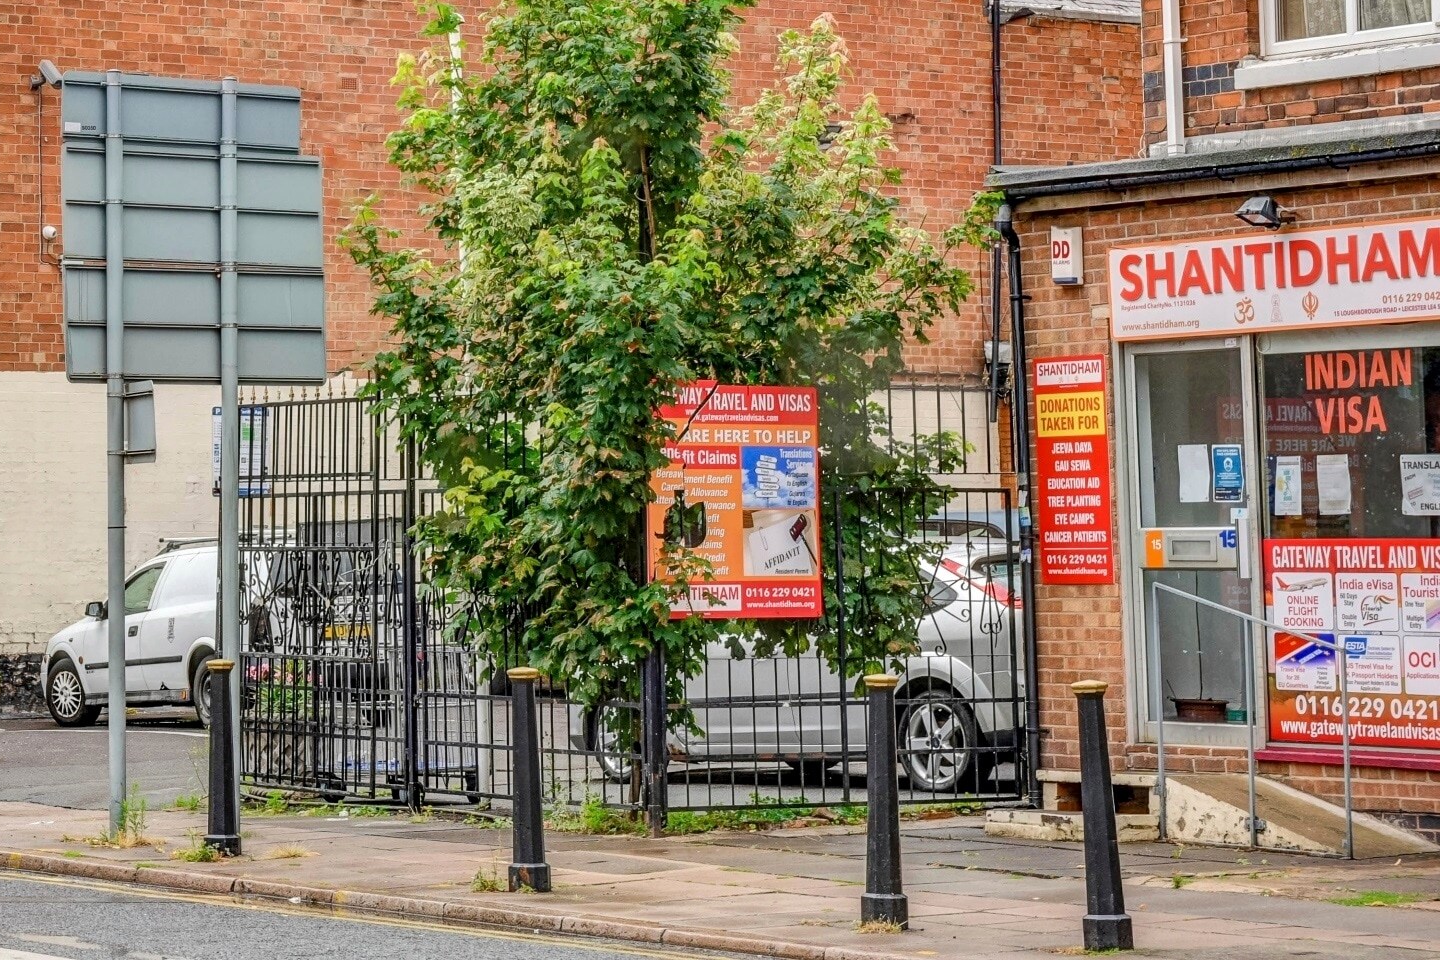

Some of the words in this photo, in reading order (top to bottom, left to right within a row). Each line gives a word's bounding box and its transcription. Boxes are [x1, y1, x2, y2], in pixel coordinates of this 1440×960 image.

[1052, 240, 1070, 259] DD
[1119, 227, 1440, 302] SHANTIDHAM
[1382, 294, 1404, 304] 0116
[1406, 292, 1422, 303] 229
[1121, 303, 1147, 312] Registered
[1340, 307, 1383, 317] LOUGHBOROUGH
[1383, 306, 1398, 314] ROAD
[1401, 304, 1427, 313] LEICESTER
[1122, 318, 1200, 332] www.shantidham.org
[1038, 362, 1100, 377] SHANTIDHAM
[1304, 348, 1413, 391] INDIAN
[751, 394, 775, 412] AND
[778, 394, 811, 412] VISAS
[1040, 397, 1101, 414] DONATIONS
[1315, 394, 1388, 435] VISA
[1041, 416, 1075, 432] TAKEN
[1078, 415, 1099, 430] FOR
[682, 428, 710, 443] ARE
[714, 429, 751, 444] HERE
[753, 430, 773, 444] TO
[776, 430, 811, 444] HELP
[779, 448, 812, 459] Translations
[1052, 442, 1074, 455] JEEVA
[1074, 441, 1093, 453] DAYA
[698, 451, 737, 465] Claims
[1054, 460, 1070, 472] GAU
[1070, 459, 1091, 472] SEWA
[707, 474, 733, 484] Benefit
[792, 480, 808, 488] English
[1047, 478, 1086, 490] EDUCATION
[1087, 477, 1100, 489] AID
[691, 487, 729, 497] Allowance
[1047, 496, 1065, 507] TREE
[1066, 495, 1101, 507] PLANTING
[1054, 513, 1068, 525] EYE
[1069, 513, 1095, 525] CAMPS
[1044, 531, 1073, 543] CANCER
[1073, 531, 1107, 542] PATIENTS
[1219, 529, 1237, 549] 15
[1151, 539, 1162, 550] 15
[703, 552, 726, 562] Credit
[763, 546, 801, 571] AFFIDAVIT
[1047, 554, 1068, 565] 0116
[1069, 554, 1085, 564] 229
[1086, 554, 1107, 564] 0421
[1272, 545, 1331, 569] GATEWAY
[1334, 545, 1385, 569] TRAVEL
[1388, 545, 1417, 569] AND
[774, 567, 793, 575] Resident
[794, 567, 809, 575] Permit
[1047, 566, 1108, 576] www.shantidham.org
[1339, 578, 1364, 590] India
[1366, 578, 1394, 590] eVisa
[745, 587, 770, 598] 0116
[772, 587, 790, 598] 229
[792, 587, 815, 597] 0421
[1403, 587, 1440, 598] Tourist
[746, 600, 815, 609] www.shantidham.org
[1286, 595, 1319, 605] ONLINE
[1288, 606, 1319, 616] FLIGHT
[1361, 611, 1379, 621] Visa
[1283, 617, 1324, 627] BOOKING
[1406, 615, 1425, 623] Multiple
[1345, 641, 1365, 651] ESTA
[1408, 651, 1436, 668] OCI
[1351, 672, 1376, 680] Passport
[1406, 672, 1440, 680] Applications
[1295, 694, 1343, 716] 0116
[1348, 696, 1385, 718] 229
[1390, 697, 1438, 720] 0421
[1280, 720, 1440, 741] www.gatewytravelandvisas
